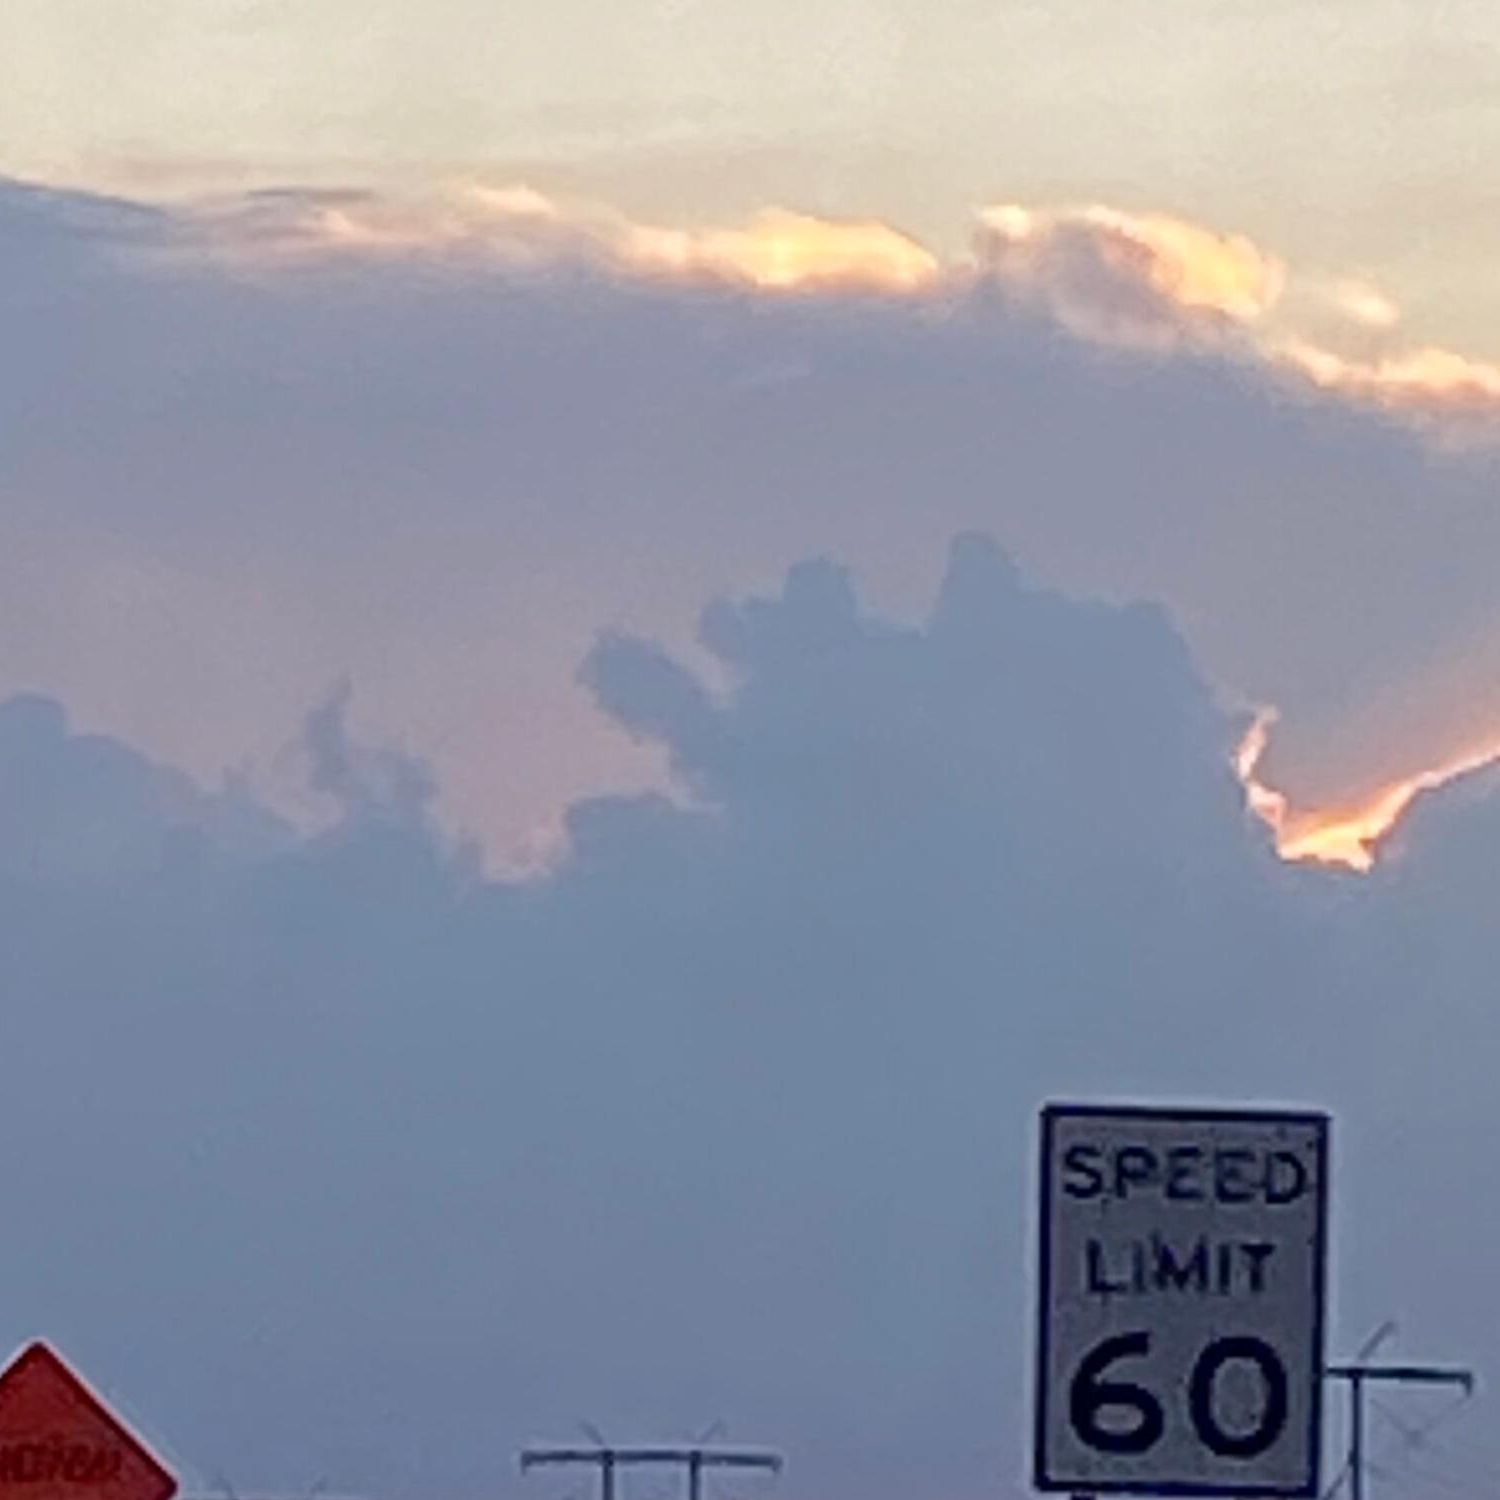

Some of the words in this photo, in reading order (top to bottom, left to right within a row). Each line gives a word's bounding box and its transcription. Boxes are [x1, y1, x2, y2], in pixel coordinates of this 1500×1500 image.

[1064, 1146, 1306, 1203] SPEED
[1085, 1238, 1277, 1294] LIMIT
[1069, 1331, 1288, 1459] 60
